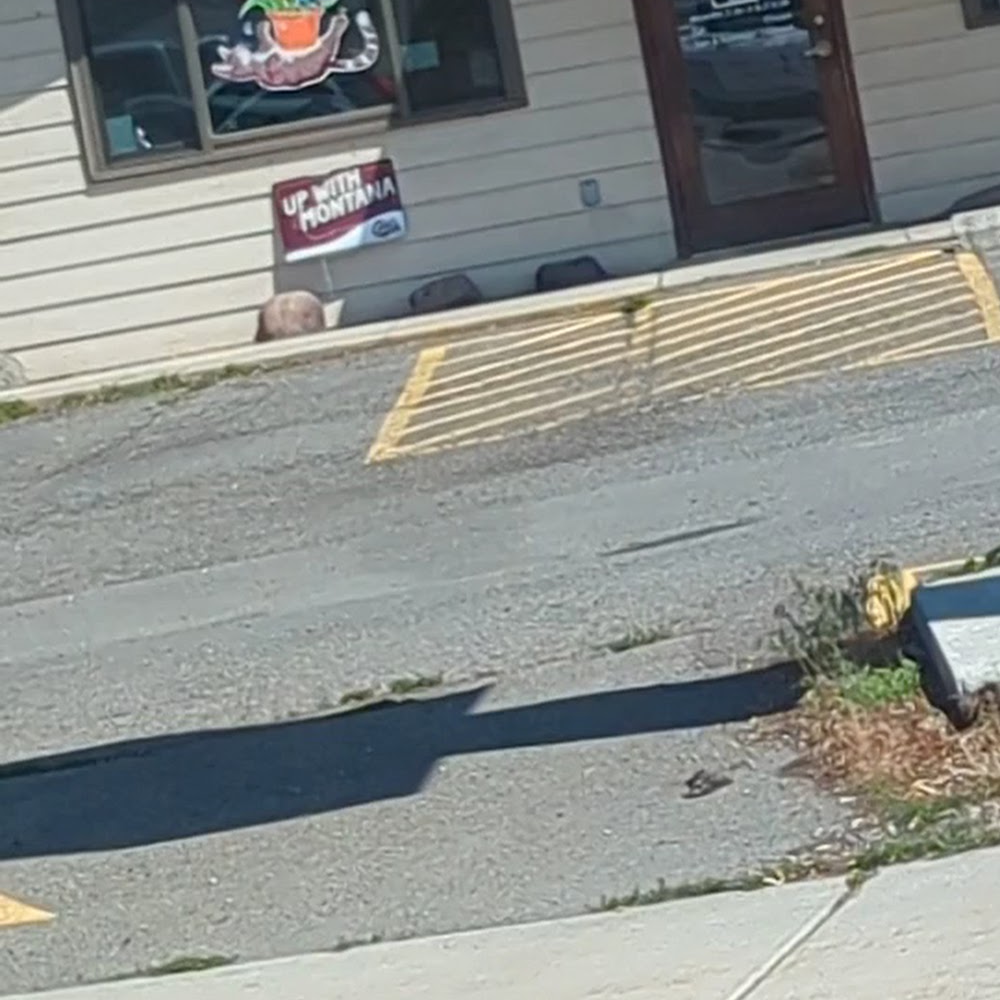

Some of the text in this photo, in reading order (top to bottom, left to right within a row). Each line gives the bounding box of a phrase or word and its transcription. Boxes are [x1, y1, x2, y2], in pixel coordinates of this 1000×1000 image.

[283, 168, 361, 217] UP WITH
[300, 176, 396, 233] MONTANA
